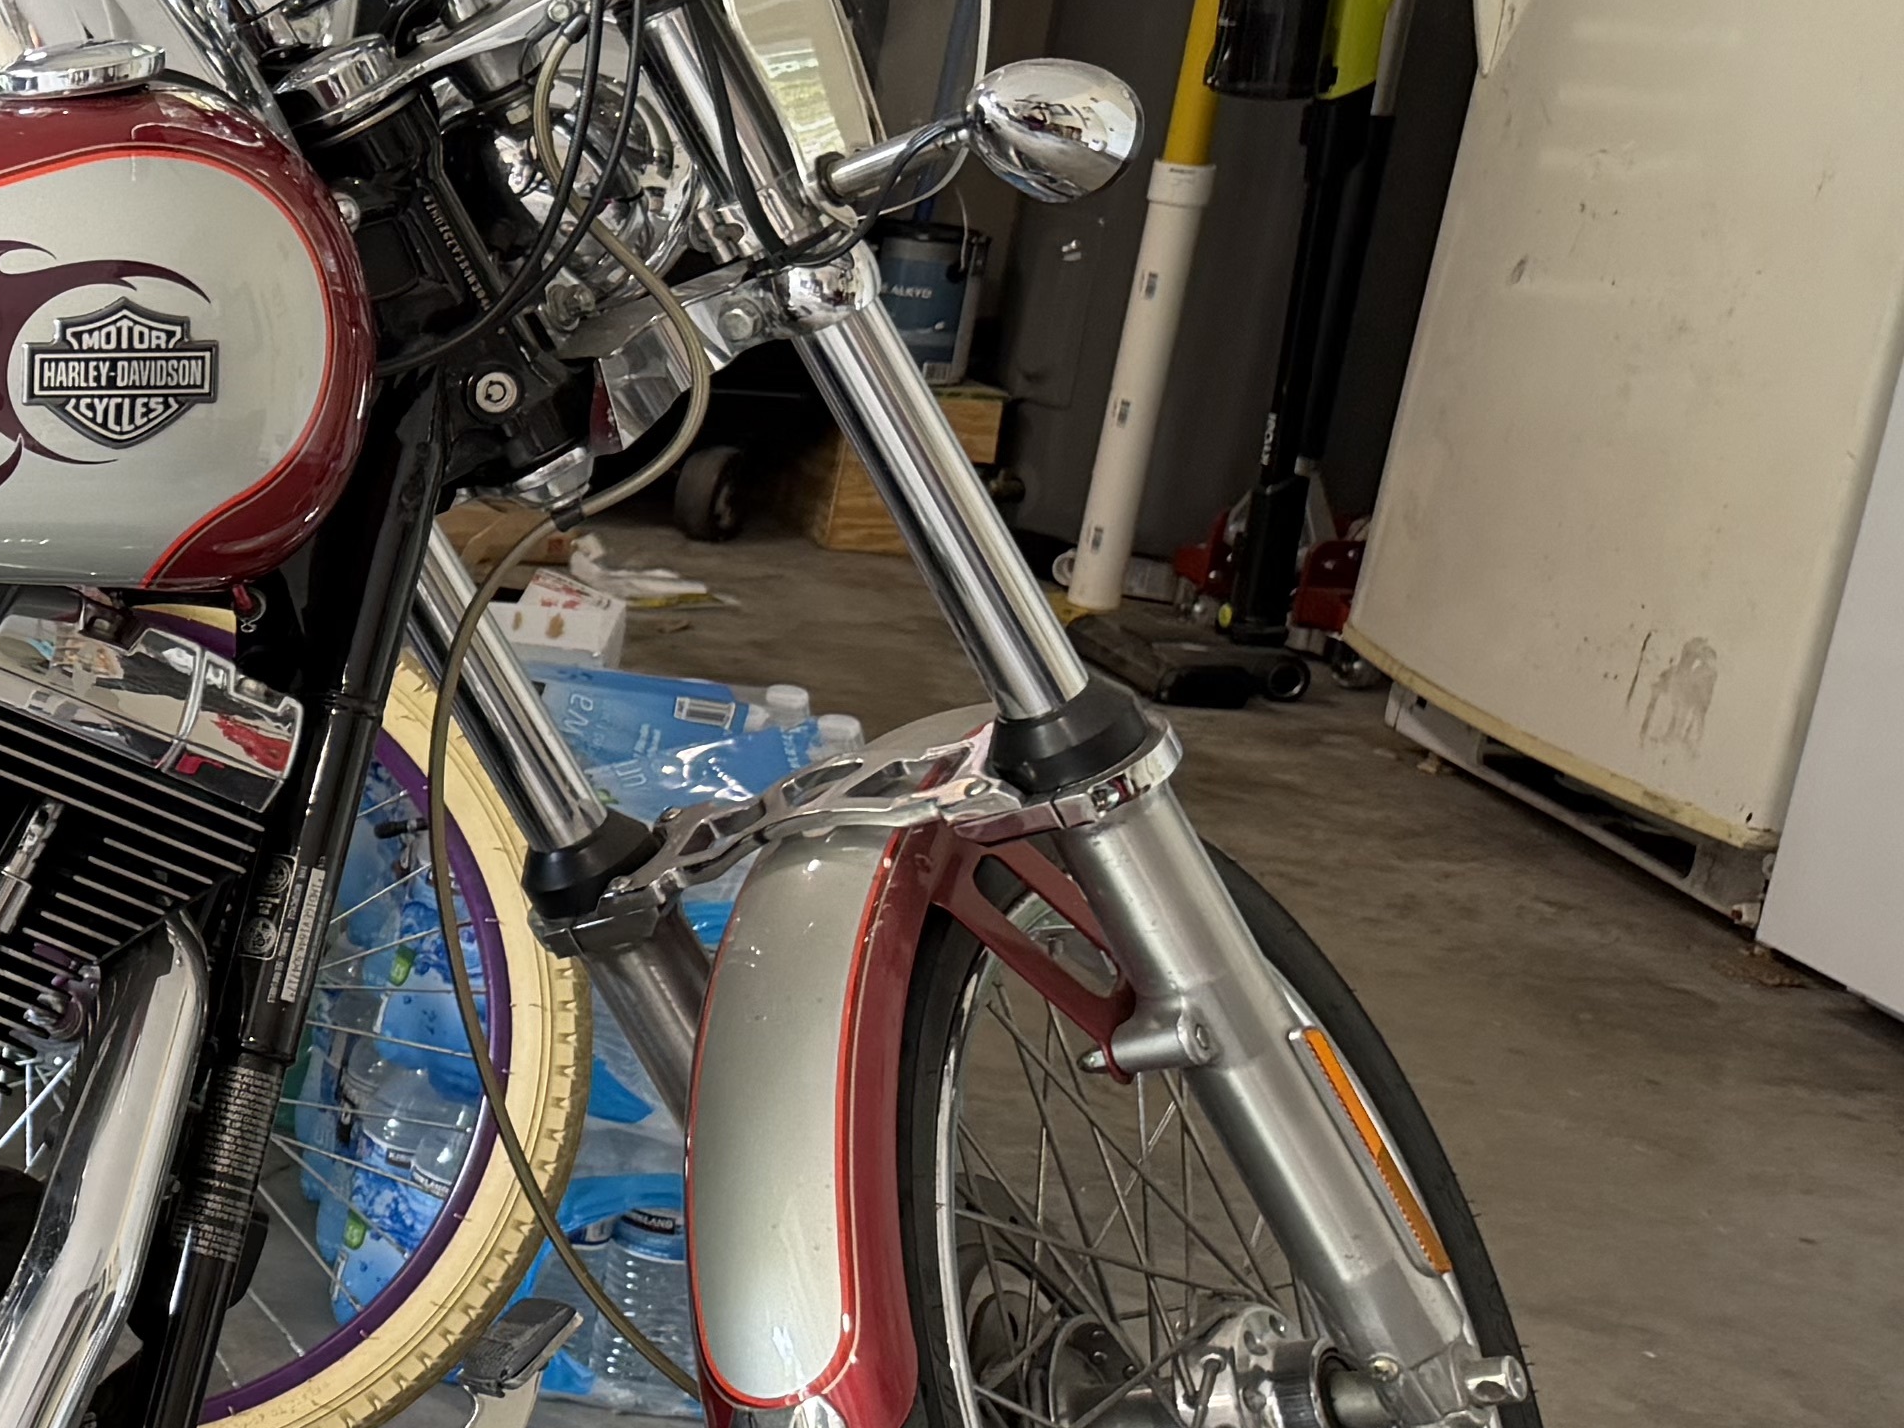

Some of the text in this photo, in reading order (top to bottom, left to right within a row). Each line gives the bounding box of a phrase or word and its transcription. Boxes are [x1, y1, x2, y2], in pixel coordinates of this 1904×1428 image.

[81, 317, 167, 350] MOTOR
[42, 358, 203, 388] HARLEY-DAVIDSON
[78, 396, 165, 432] CYCLES
